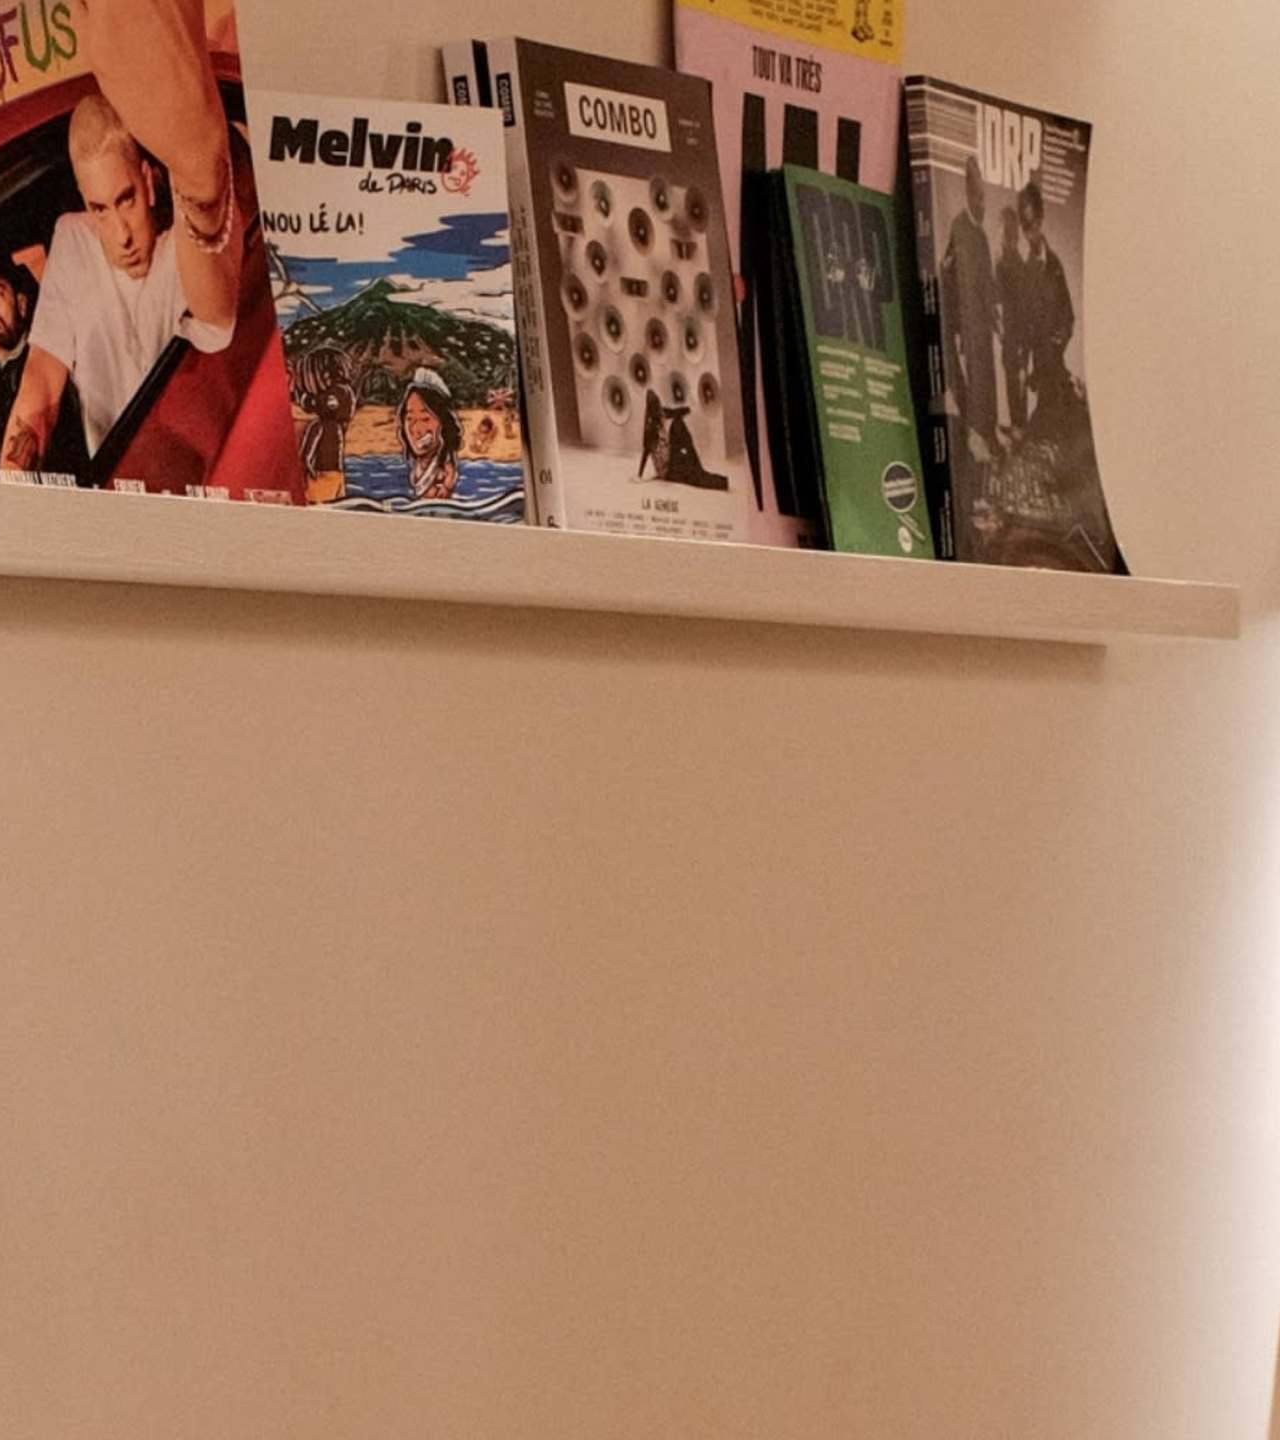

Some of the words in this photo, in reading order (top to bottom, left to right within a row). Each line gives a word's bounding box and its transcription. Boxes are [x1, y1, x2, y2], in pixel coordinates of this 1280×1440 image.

[753, 45, 776, 82] TOUT
[779, 53, 793, 86] VA
[578, 95, 657, 139] COMBO
[269, 116, 455, 173] Melvin
[359, 171, 383, 193] de
[263, 212, 301, 234] NOU
[310, 203, 330, 233] LÉ
